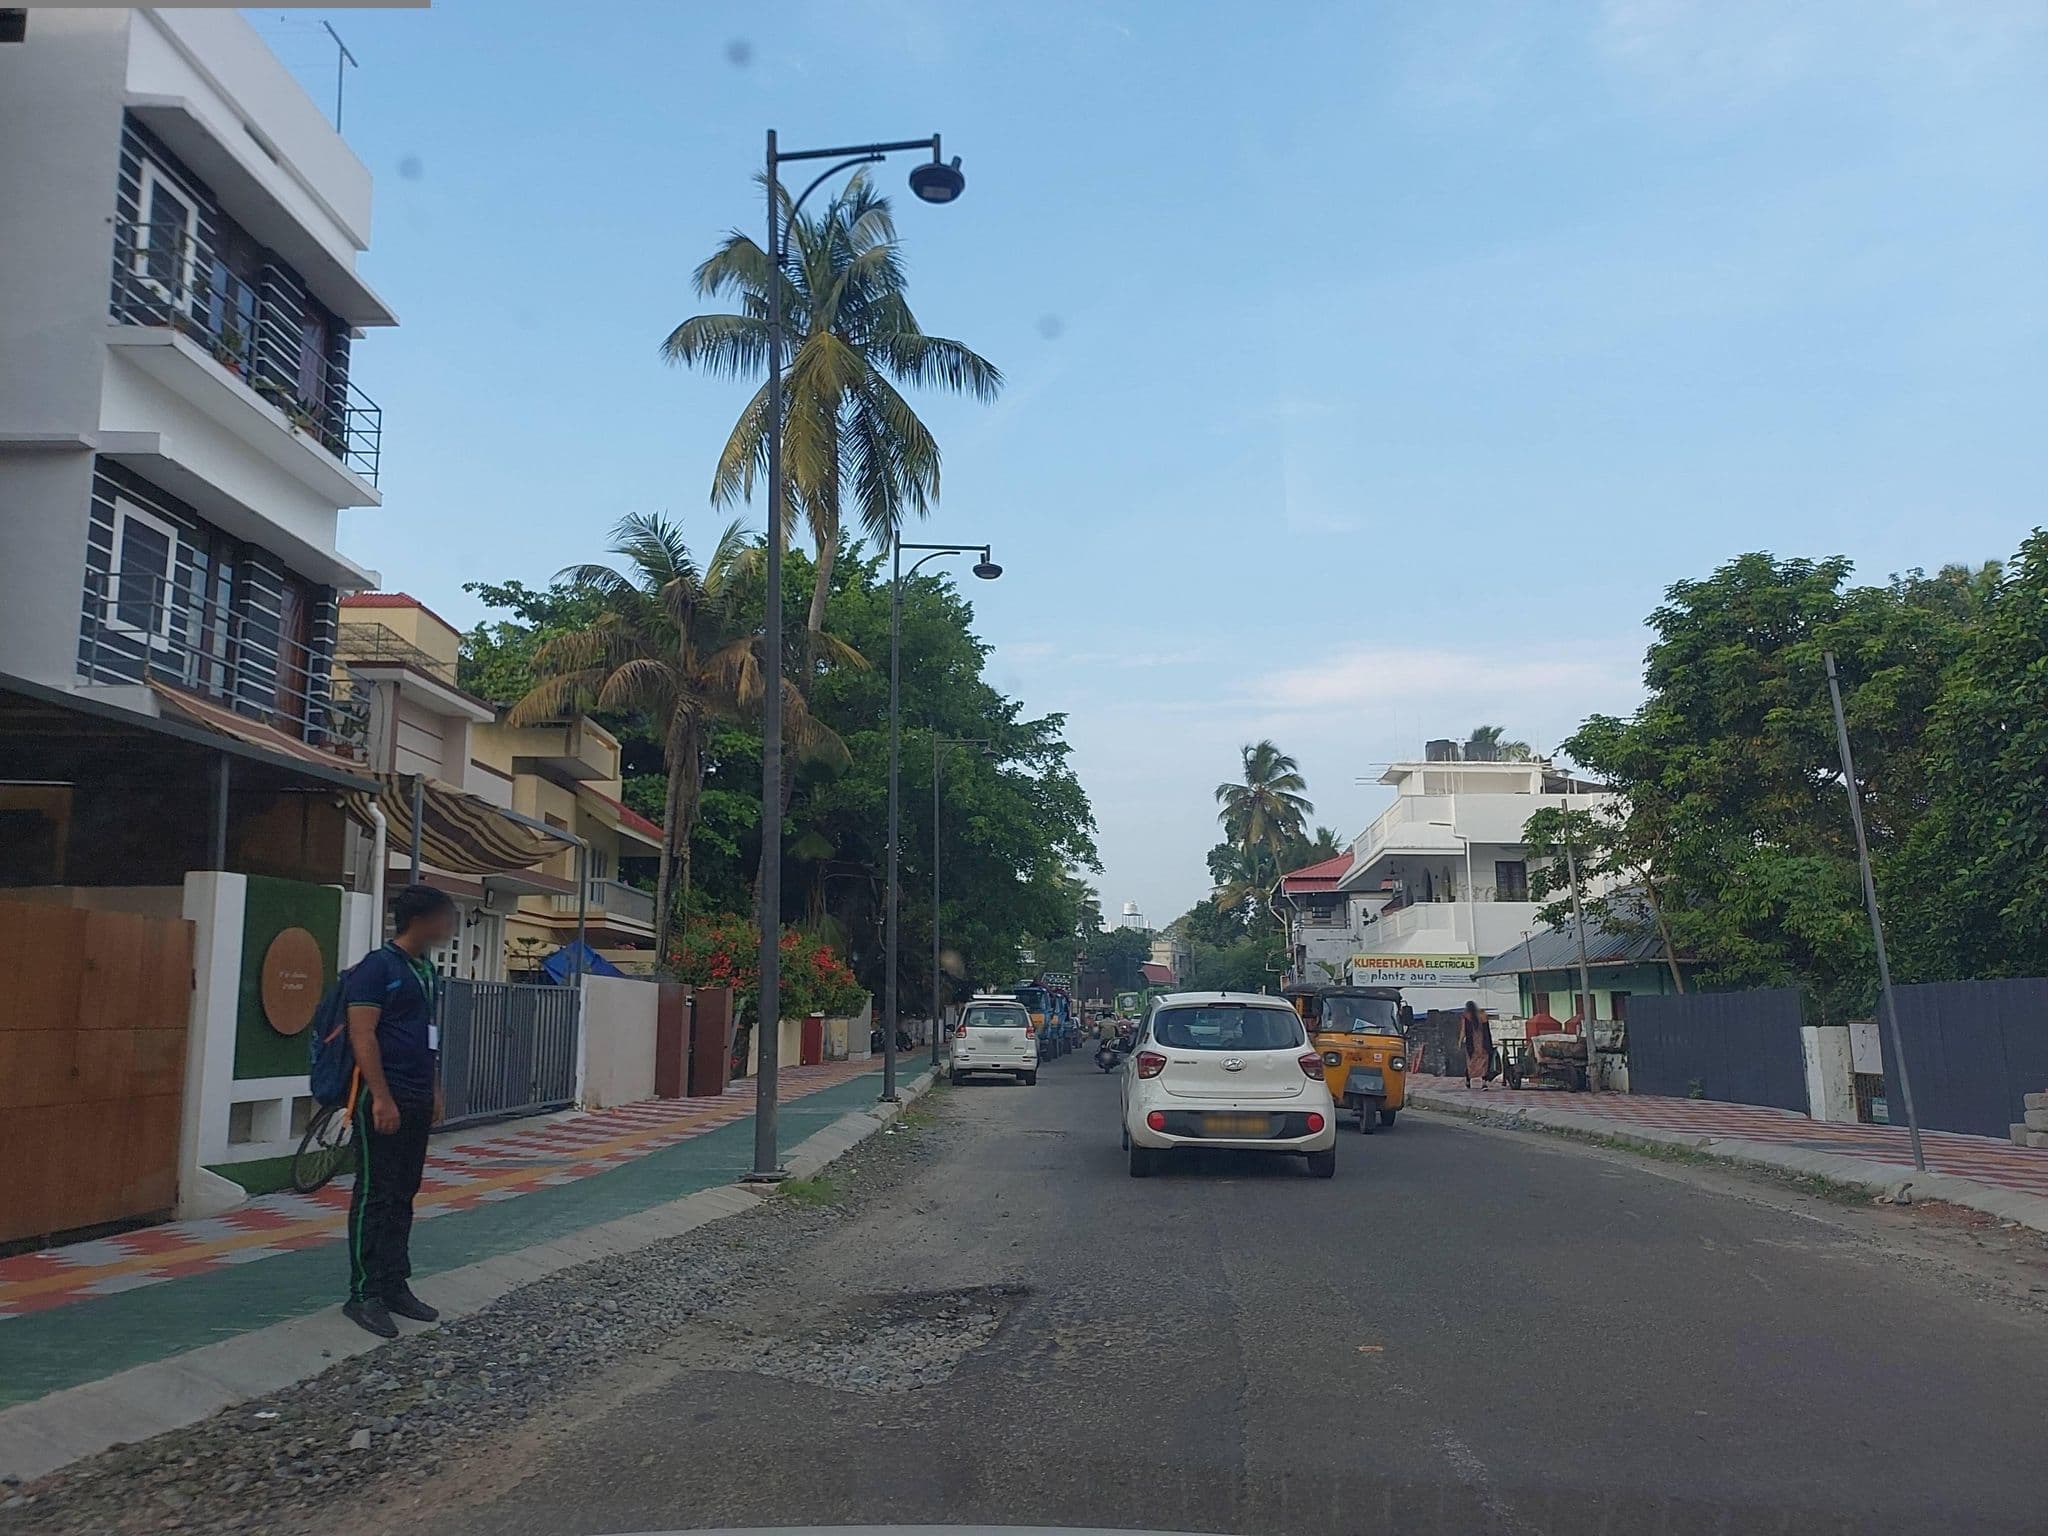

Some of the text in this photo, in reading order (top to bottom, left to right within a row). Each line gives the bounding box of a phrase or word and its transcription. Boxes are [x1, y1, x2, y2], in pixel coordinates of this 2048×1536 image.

[1354, 958, 1475, 969] KUREETHARA ELECTRICALS
[1410, 973, 1437, 981] aura
